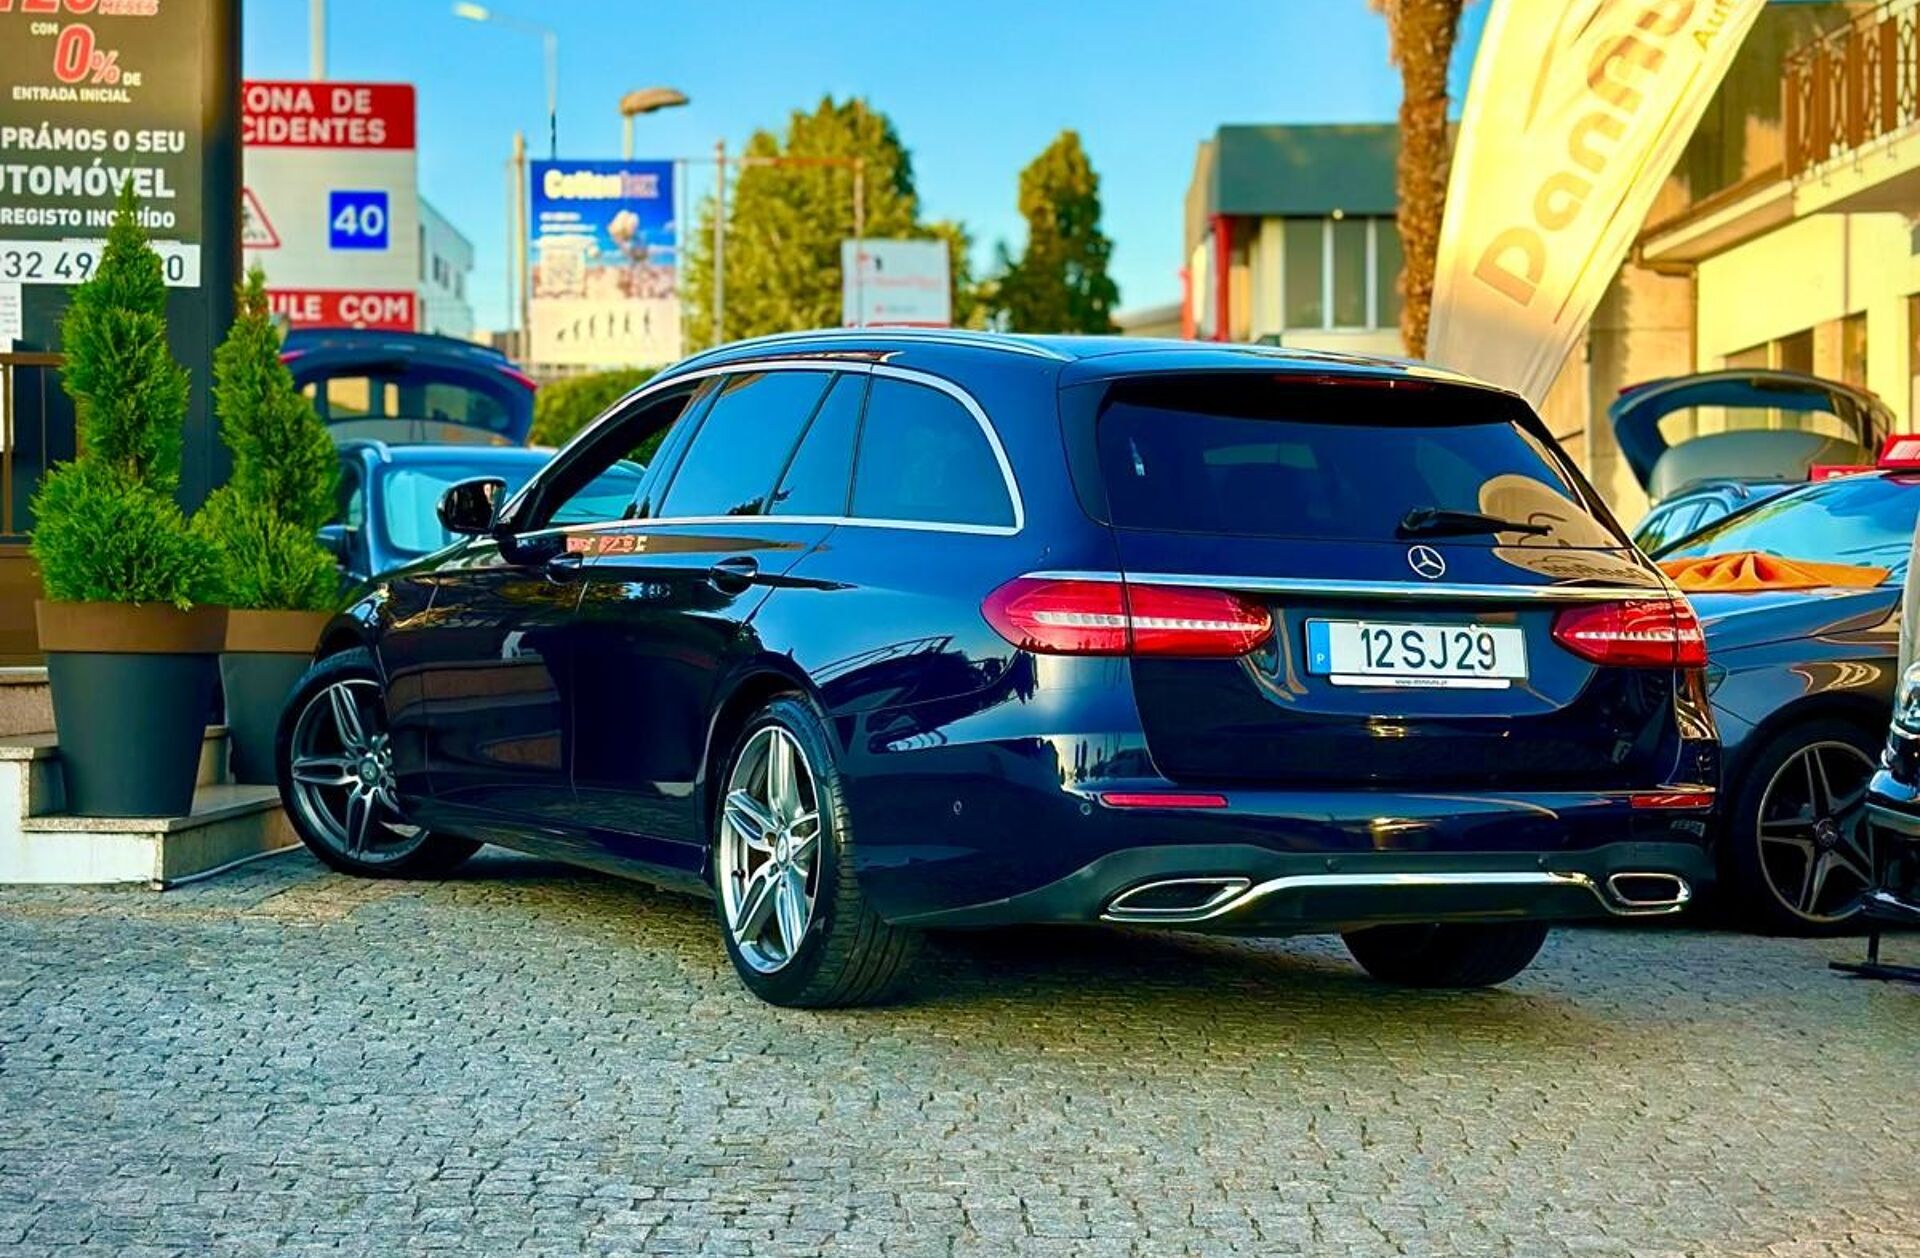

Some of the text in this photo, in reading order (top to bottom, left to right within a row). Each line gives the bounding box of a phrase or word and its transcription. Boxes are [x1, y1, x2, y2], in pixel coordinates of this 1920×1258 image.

[30, 21, 58, 35] COM
[122, 71, 142, 86] DE
[13, 85, 131, 103] ENTRADA INICIAL
[243, 85, 373, 115] ONA DE
[1, 121, 186, 153] PRÁMOS O SEU
[0, 157, 176, 198] TOMÓVEL
[1, 207, 82, 226] REGISTO
[333, 203, 384, 237] 40
[338, 295, 409, 323] COM
[1360, 628, 1498, 672] 12SJ29
